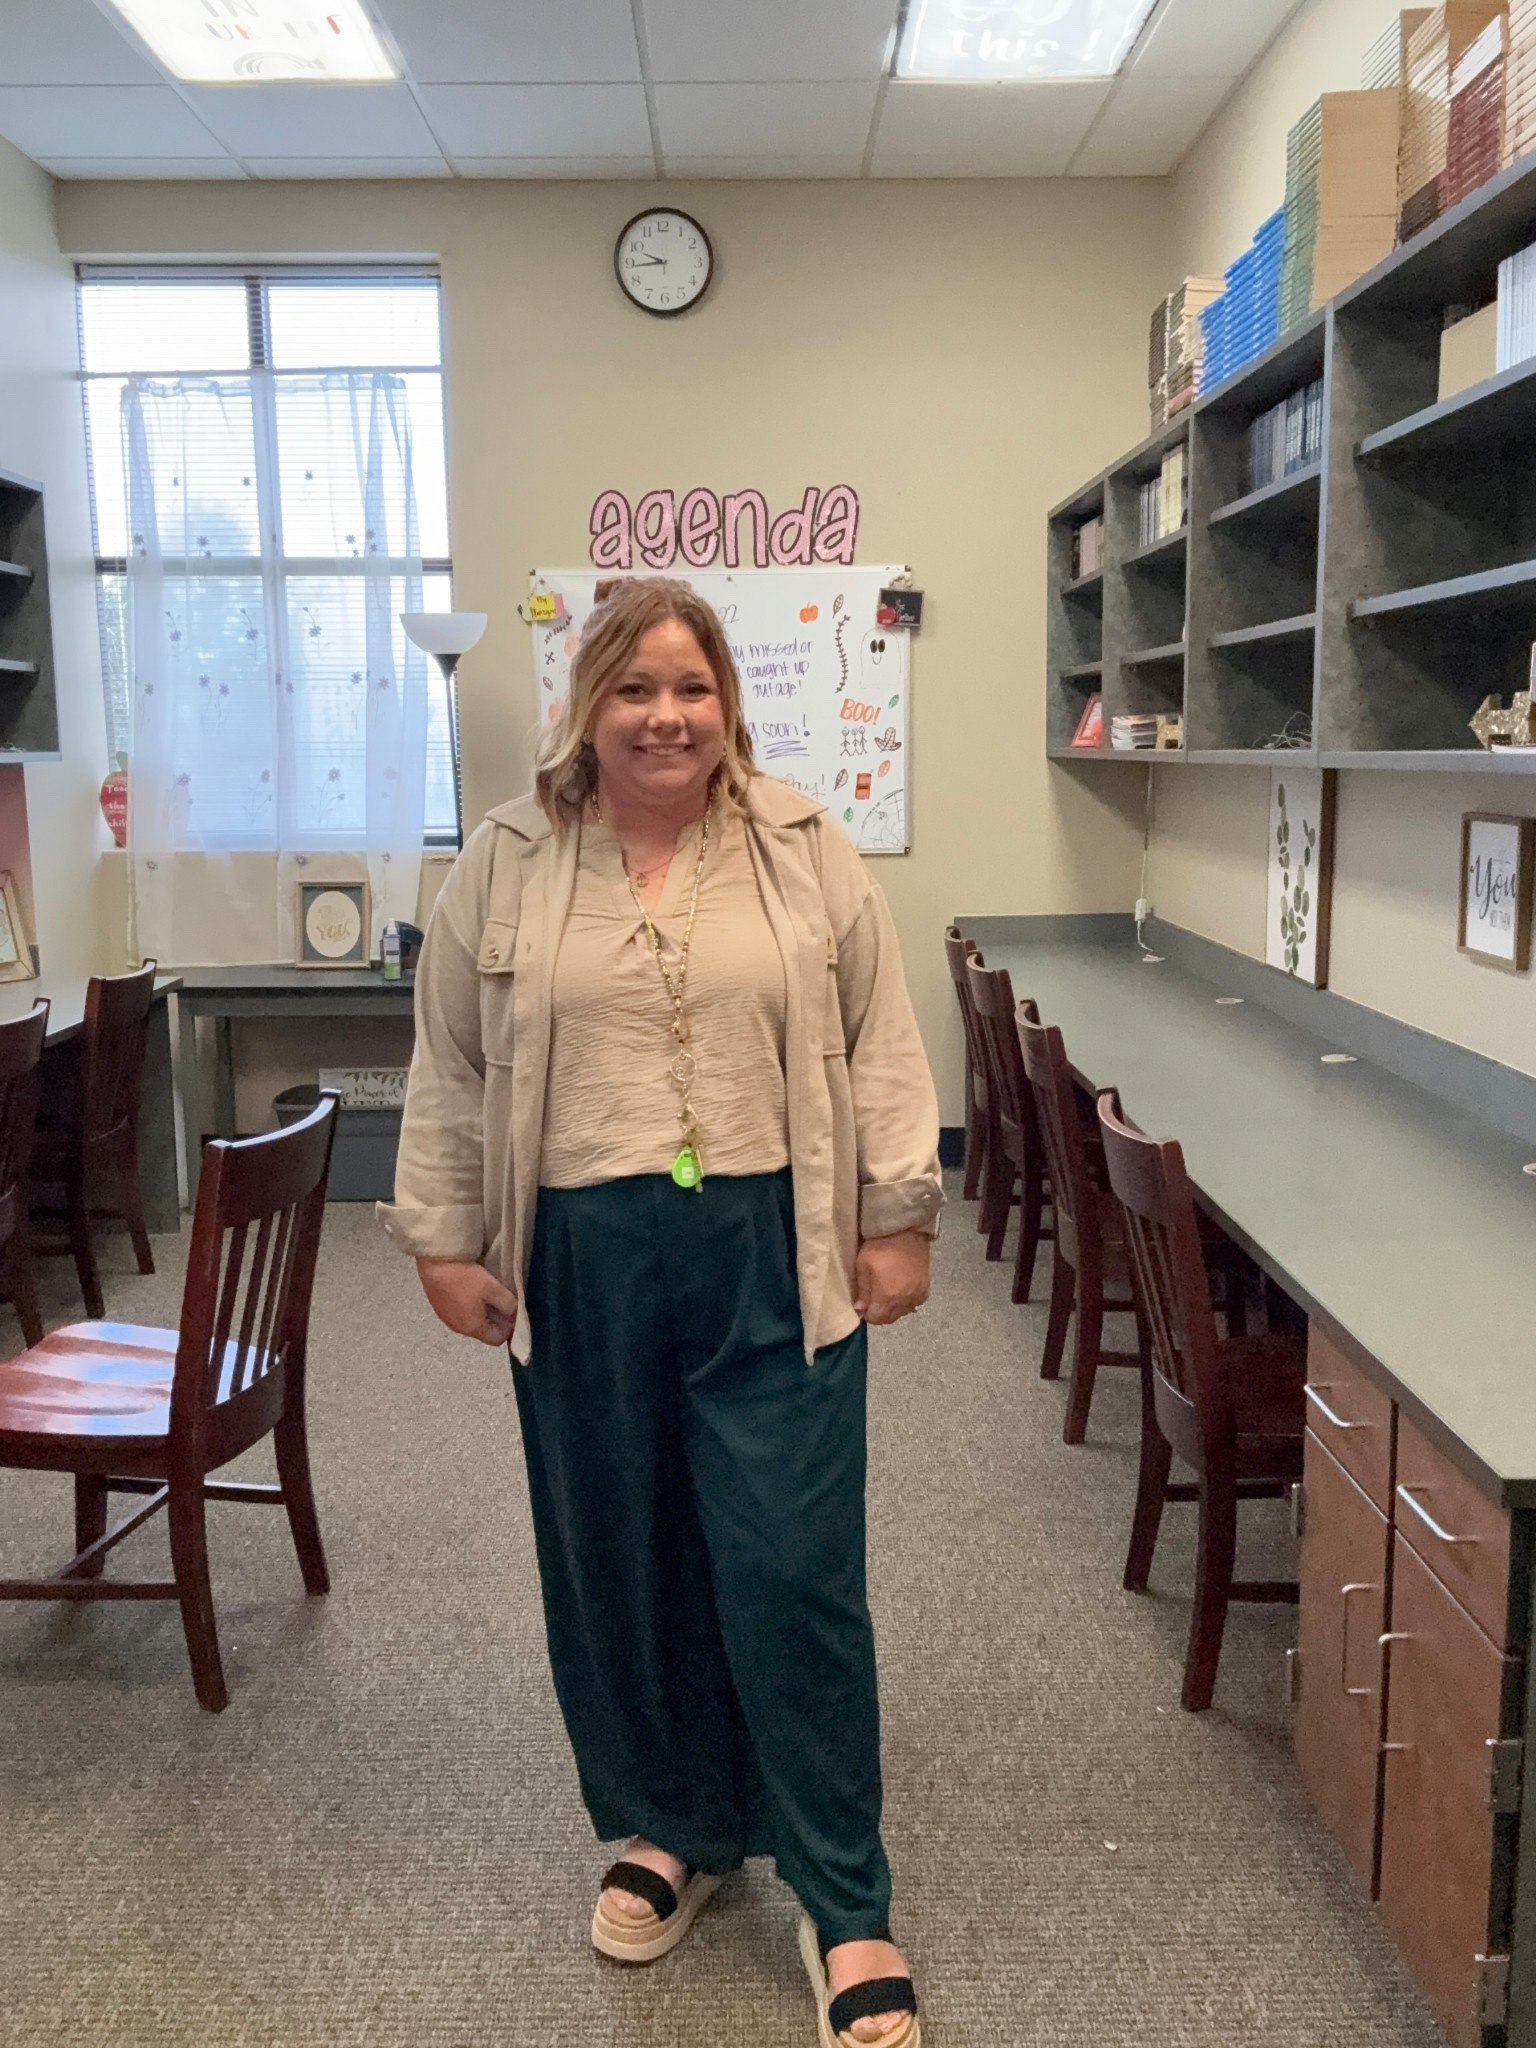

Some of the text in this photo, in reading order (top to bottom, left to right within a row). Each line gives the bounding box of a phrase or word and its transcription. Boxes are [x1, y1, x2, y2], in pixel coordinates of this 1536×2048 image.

[643, 225, 652, 238] 11
[657, 220, 670, 233] 12
[630, 240, 645, 253] 10
[687, 237, 697, 250] 2
[693, 256, 703, 269] 3
[631, 274, 642, 287] 8
[687, 274, 697, 287] 4
[644, 287, 654, 300] 7
[660, 292, 670, 305] 6
[676, 287, 686, 300] 5
[589, 484, 860, 569] agenda
[748, 637, 798, 659] missed
[800, 640, 814, 654] or
[746, 661, 789, 680] caught
[839, 698, 881, 726] BOO!
